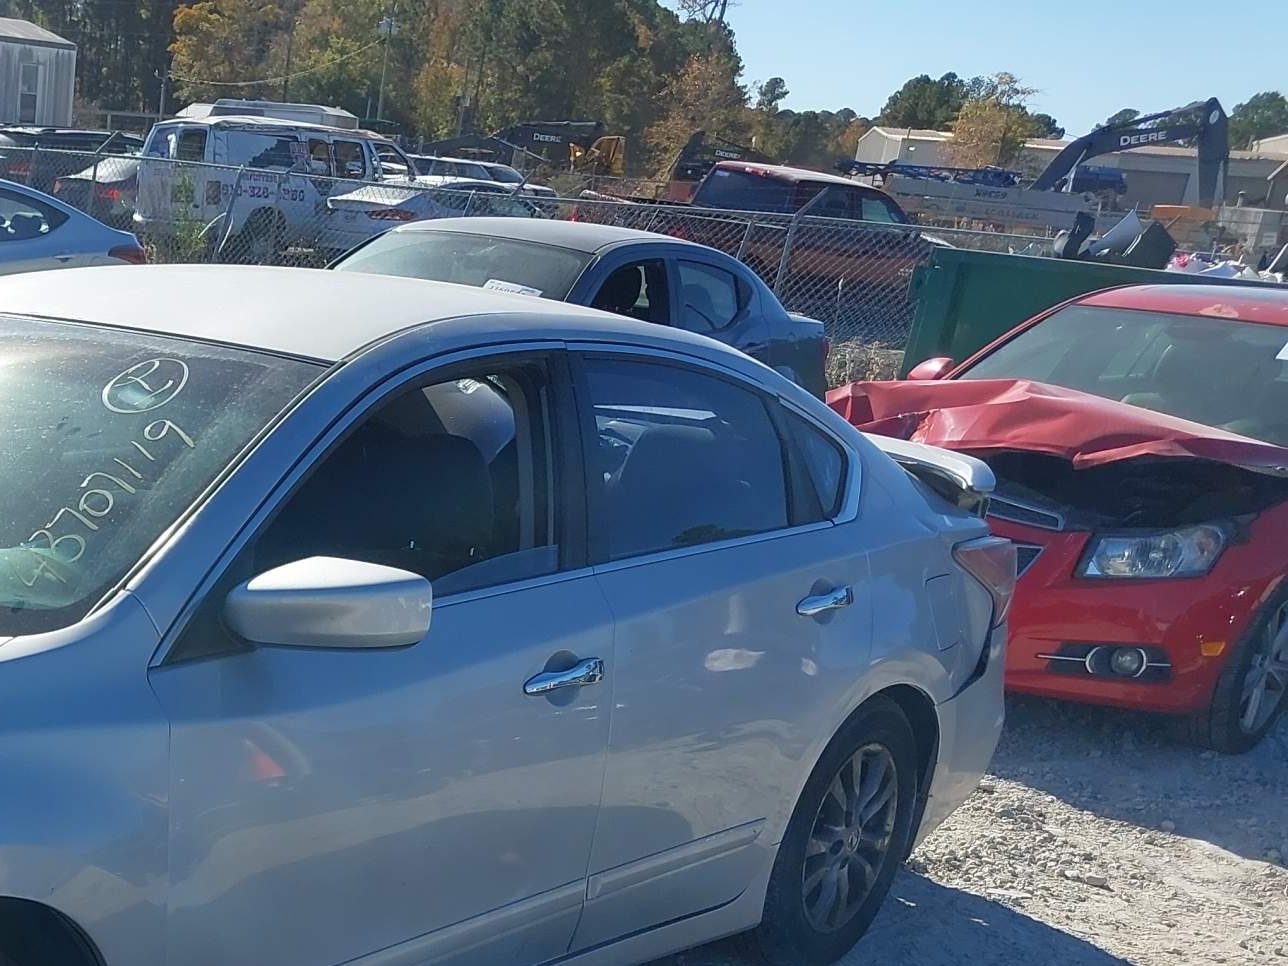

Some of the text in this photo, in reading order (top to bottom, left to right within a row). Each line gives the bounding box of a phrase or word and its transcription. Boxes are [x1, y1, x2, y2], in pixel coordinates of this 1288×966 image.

[533, 132, 562, 143] DEERE
[1119, 131, 1168, 147] DEERE
[13, 418, 196, 588] 43707119
